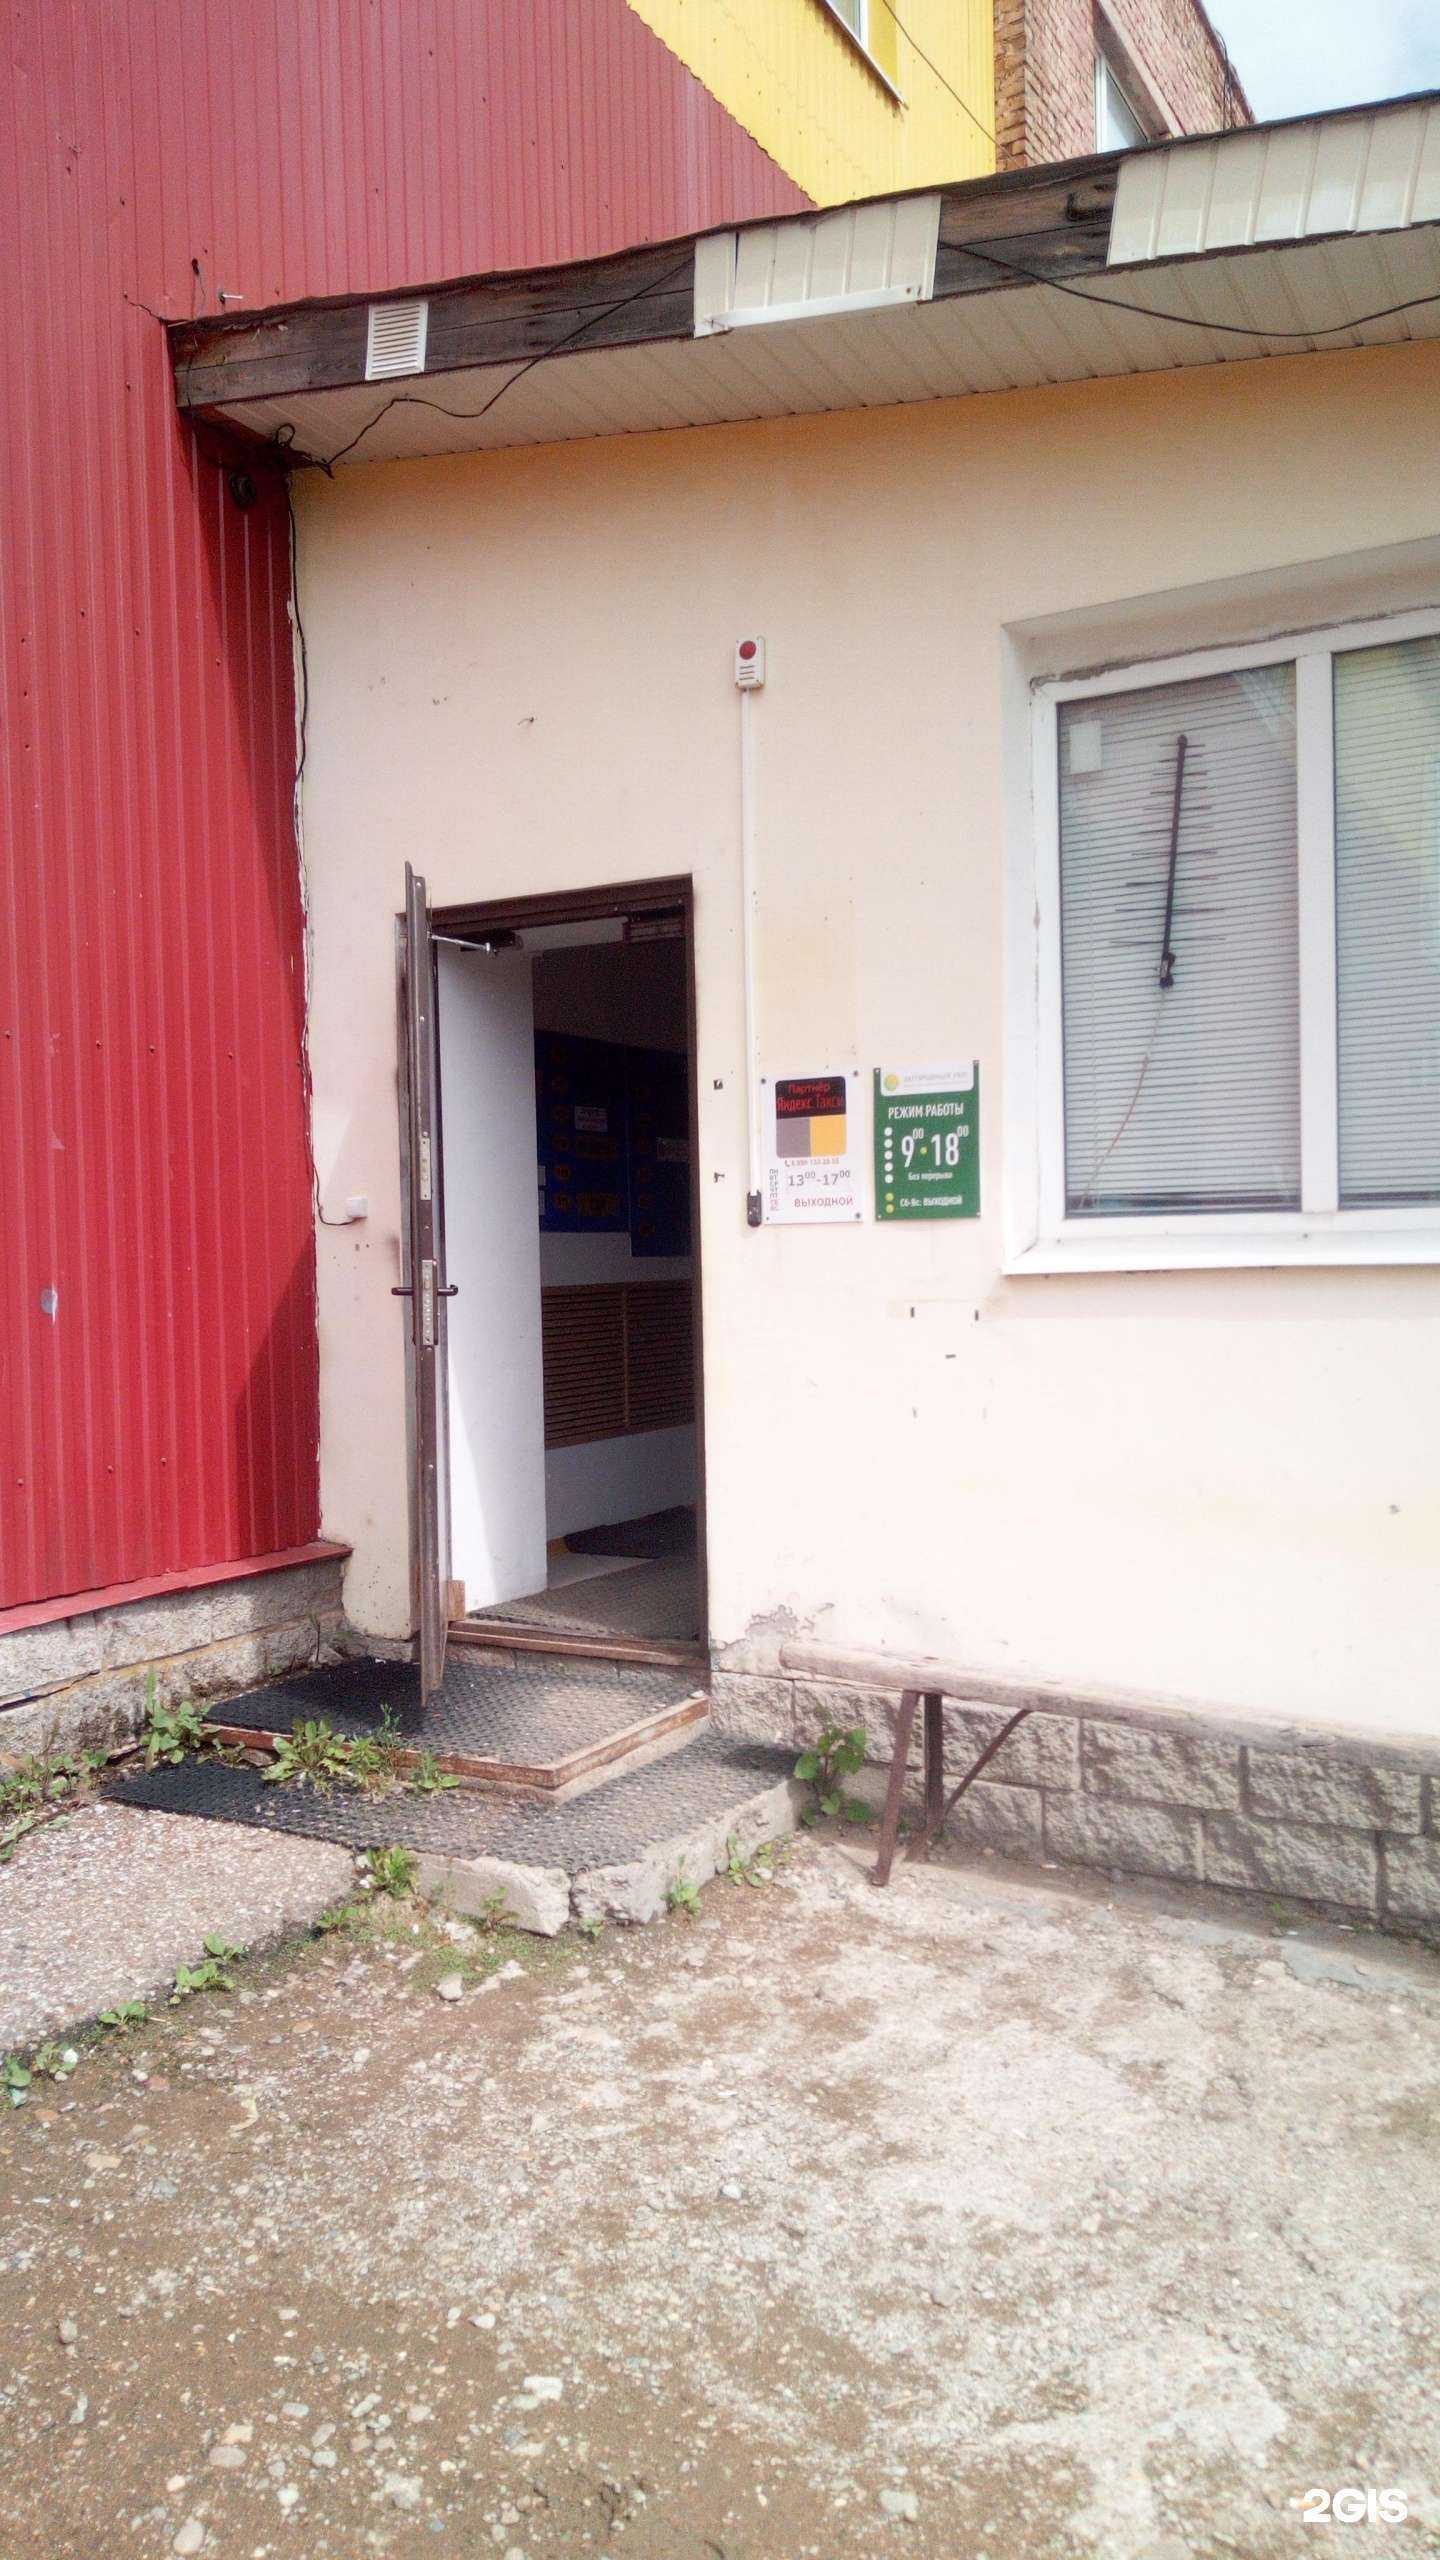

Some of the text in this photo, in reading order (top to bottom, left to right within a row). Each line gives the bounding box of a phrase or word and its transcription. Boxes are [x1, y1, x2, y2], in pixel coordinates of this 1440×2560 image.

[777, 1095, 844, 1112] Яндекс Такси
[888, 1102, 964, 1119] РЕЖИМ РАБОТЫ
[794, 1196, 853, 1208] ВЫХОДНОЙ
